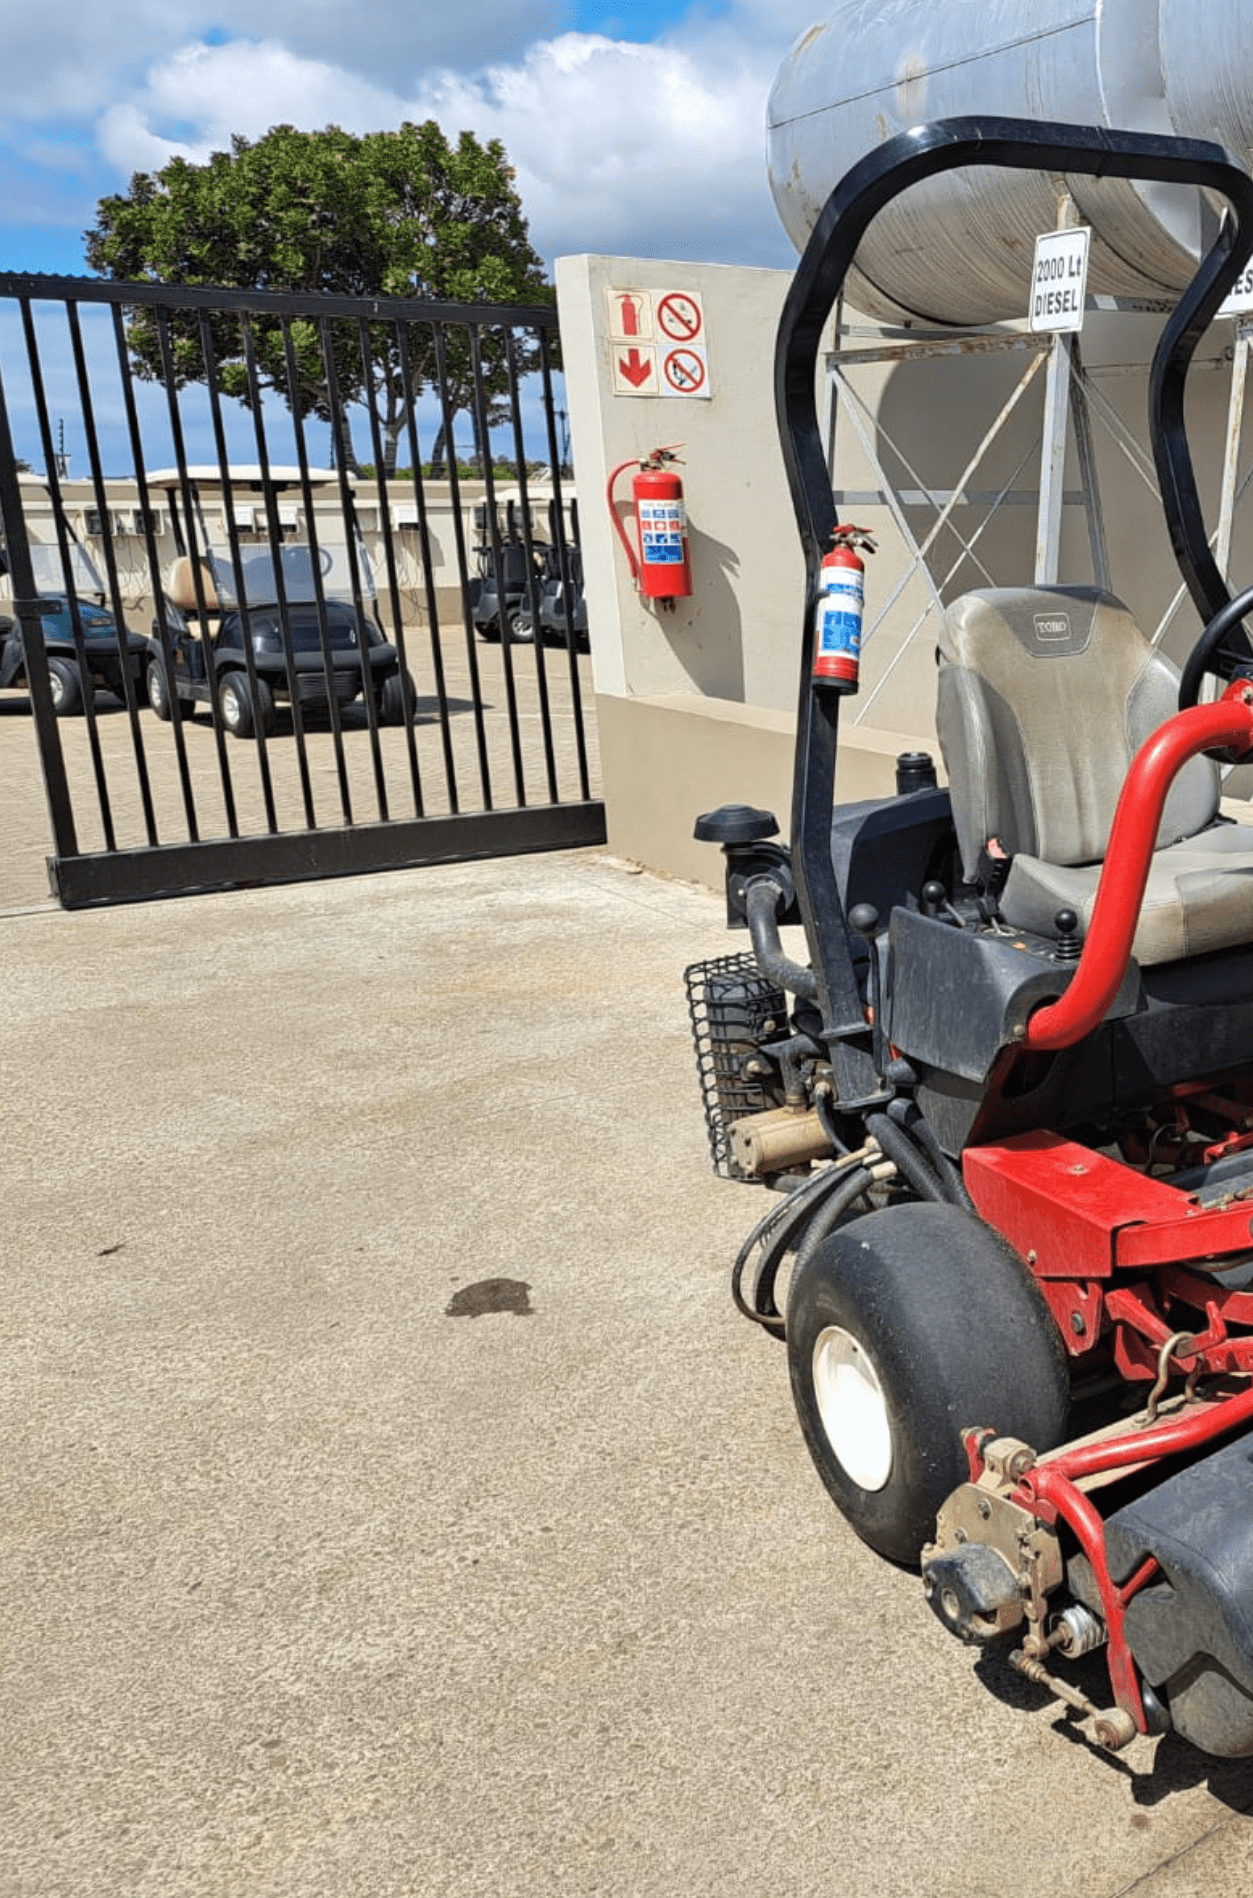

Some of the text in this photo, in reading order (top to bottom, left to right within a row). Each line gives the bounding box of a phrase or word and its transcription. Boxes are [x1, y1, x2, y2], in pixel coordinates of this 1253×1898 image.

[1036, 255, 1081, 282] 2000 Lt
[1035, 288, 1077, 317] DIESEL
[1037, 620, 1067, 633] TORO
